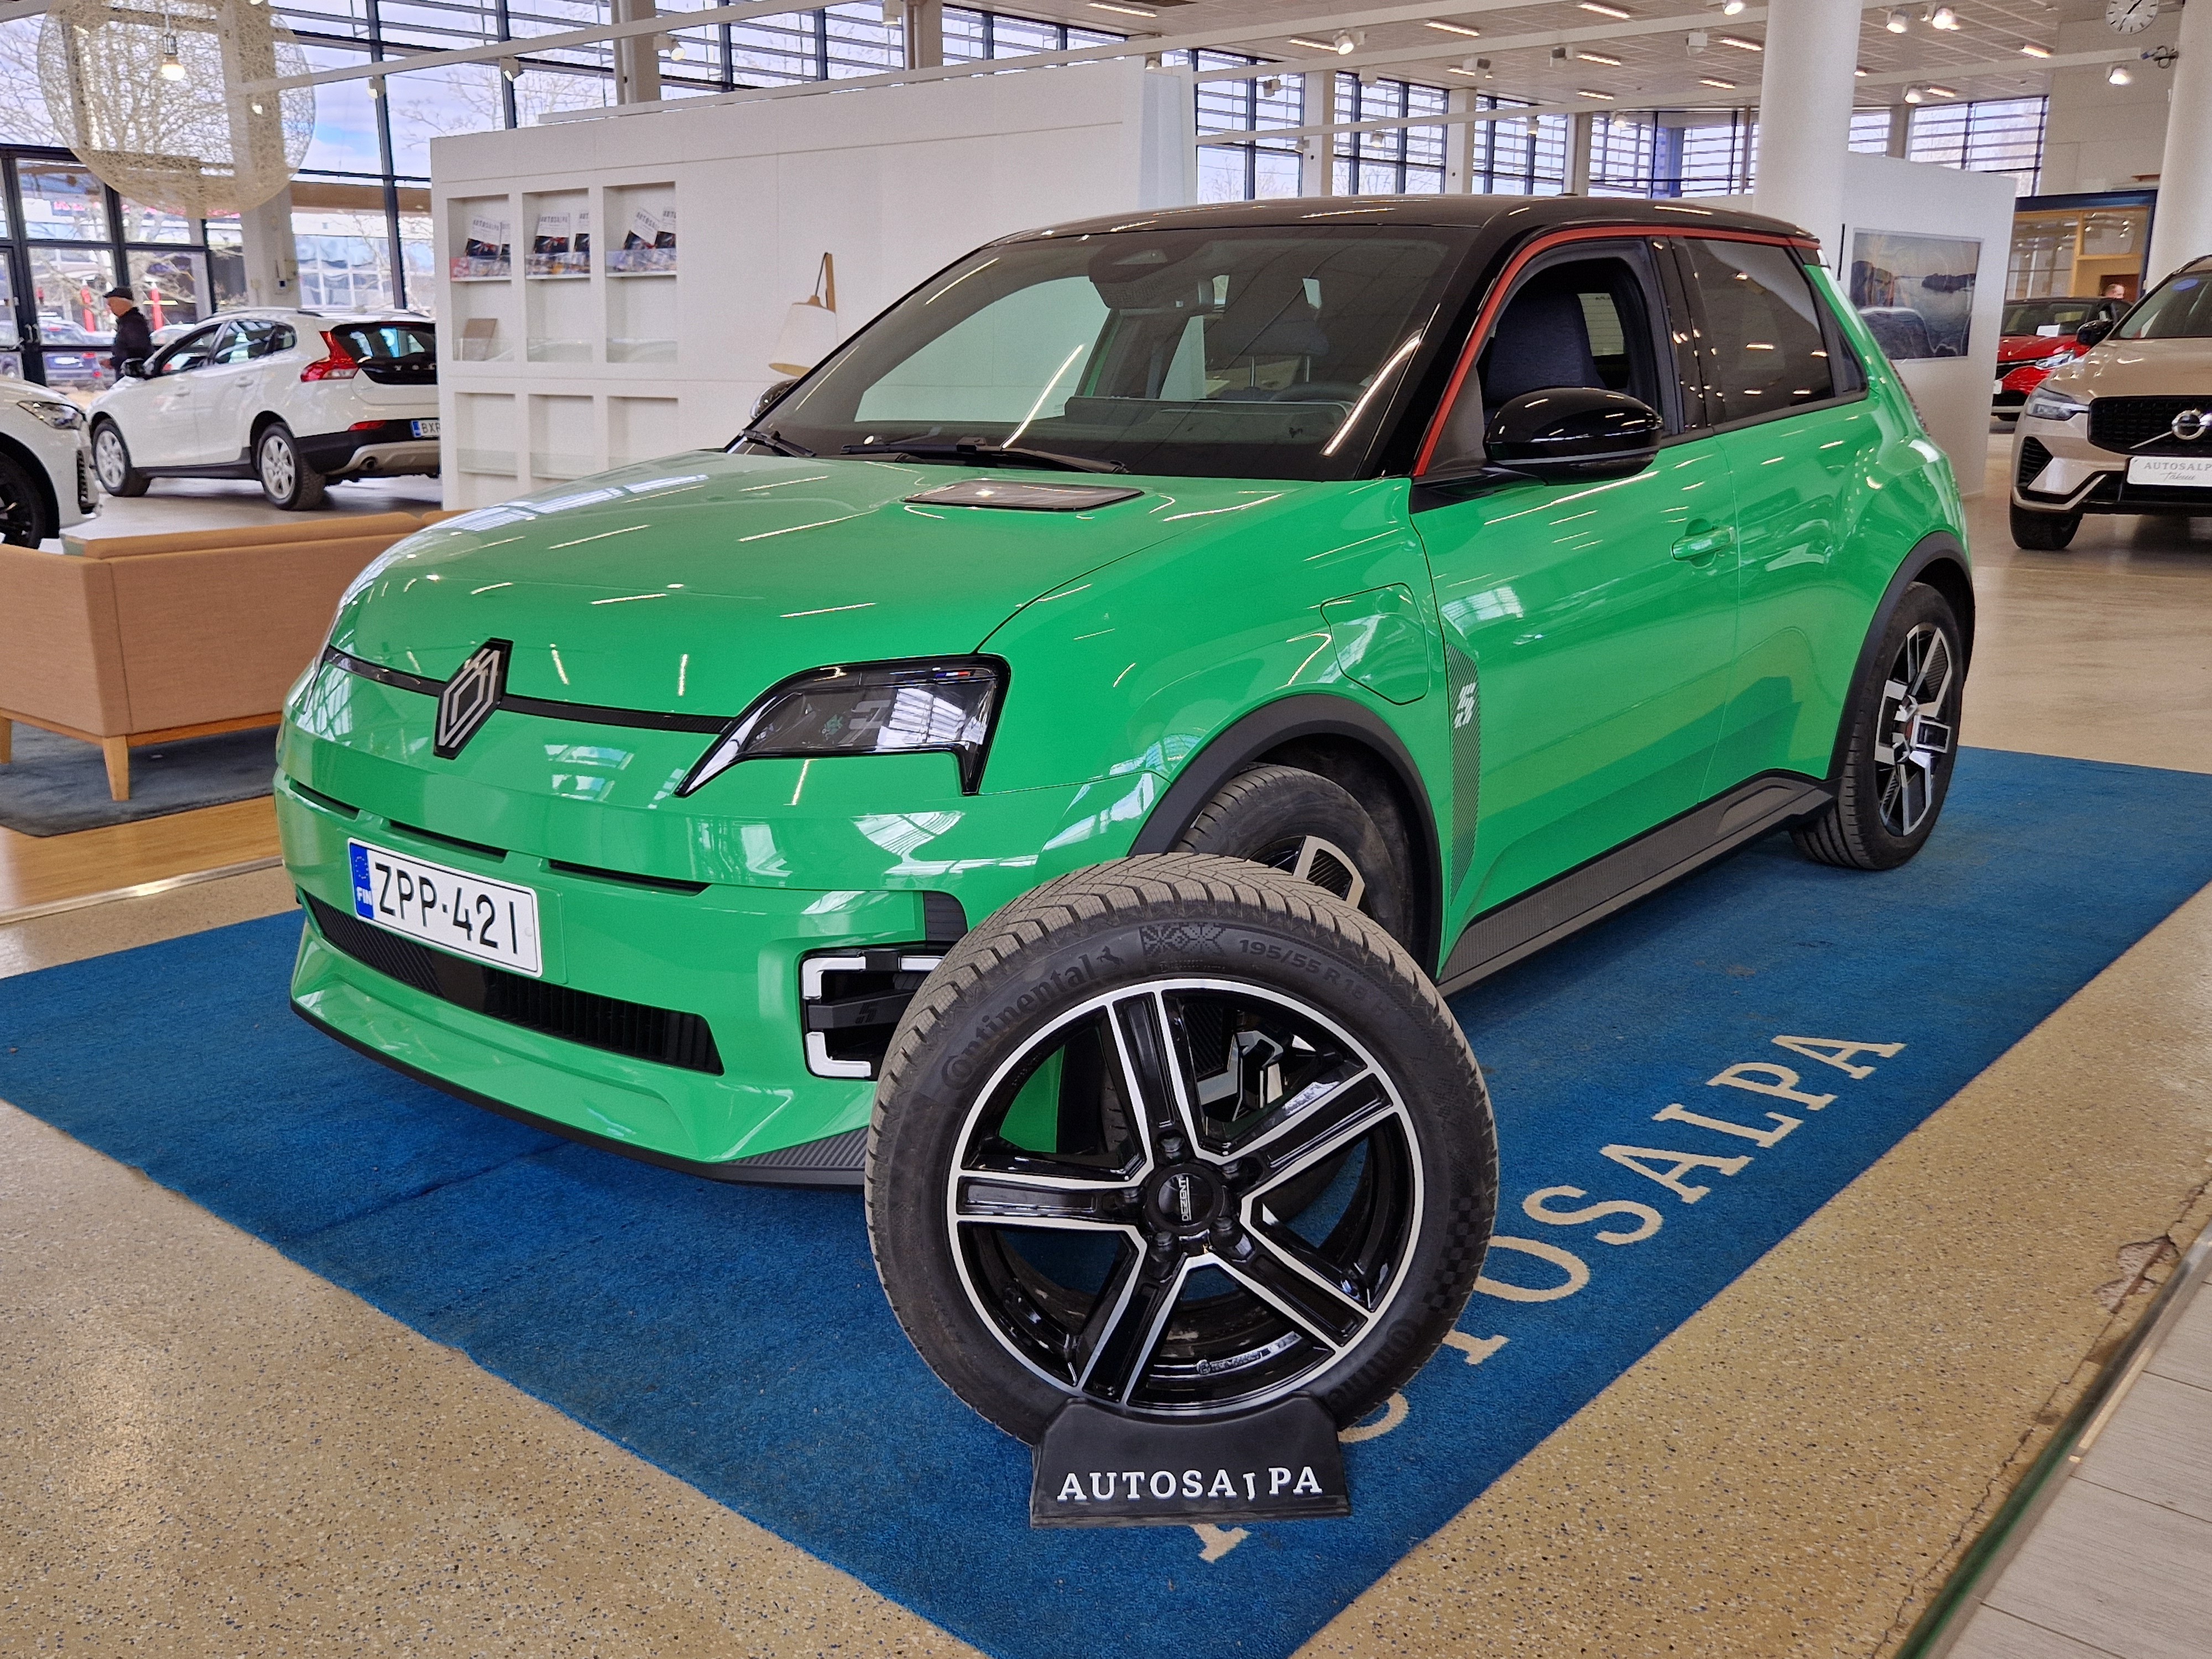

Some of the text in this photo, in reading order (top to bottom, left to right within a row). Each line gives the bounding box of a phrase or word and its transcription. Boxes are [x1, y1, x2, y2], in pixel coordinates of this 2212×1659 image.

[2144, 462, 2212, 471] AUTOSALP
[357, 886, 373, 906] FIN
[375, 862, 519, 955] ZPP-421
[1239, 939, 1322, 974] 195/55
[942, 953, 1099, 1090] Continental
[1178, 1177, 1190, 1222] DEZENT
